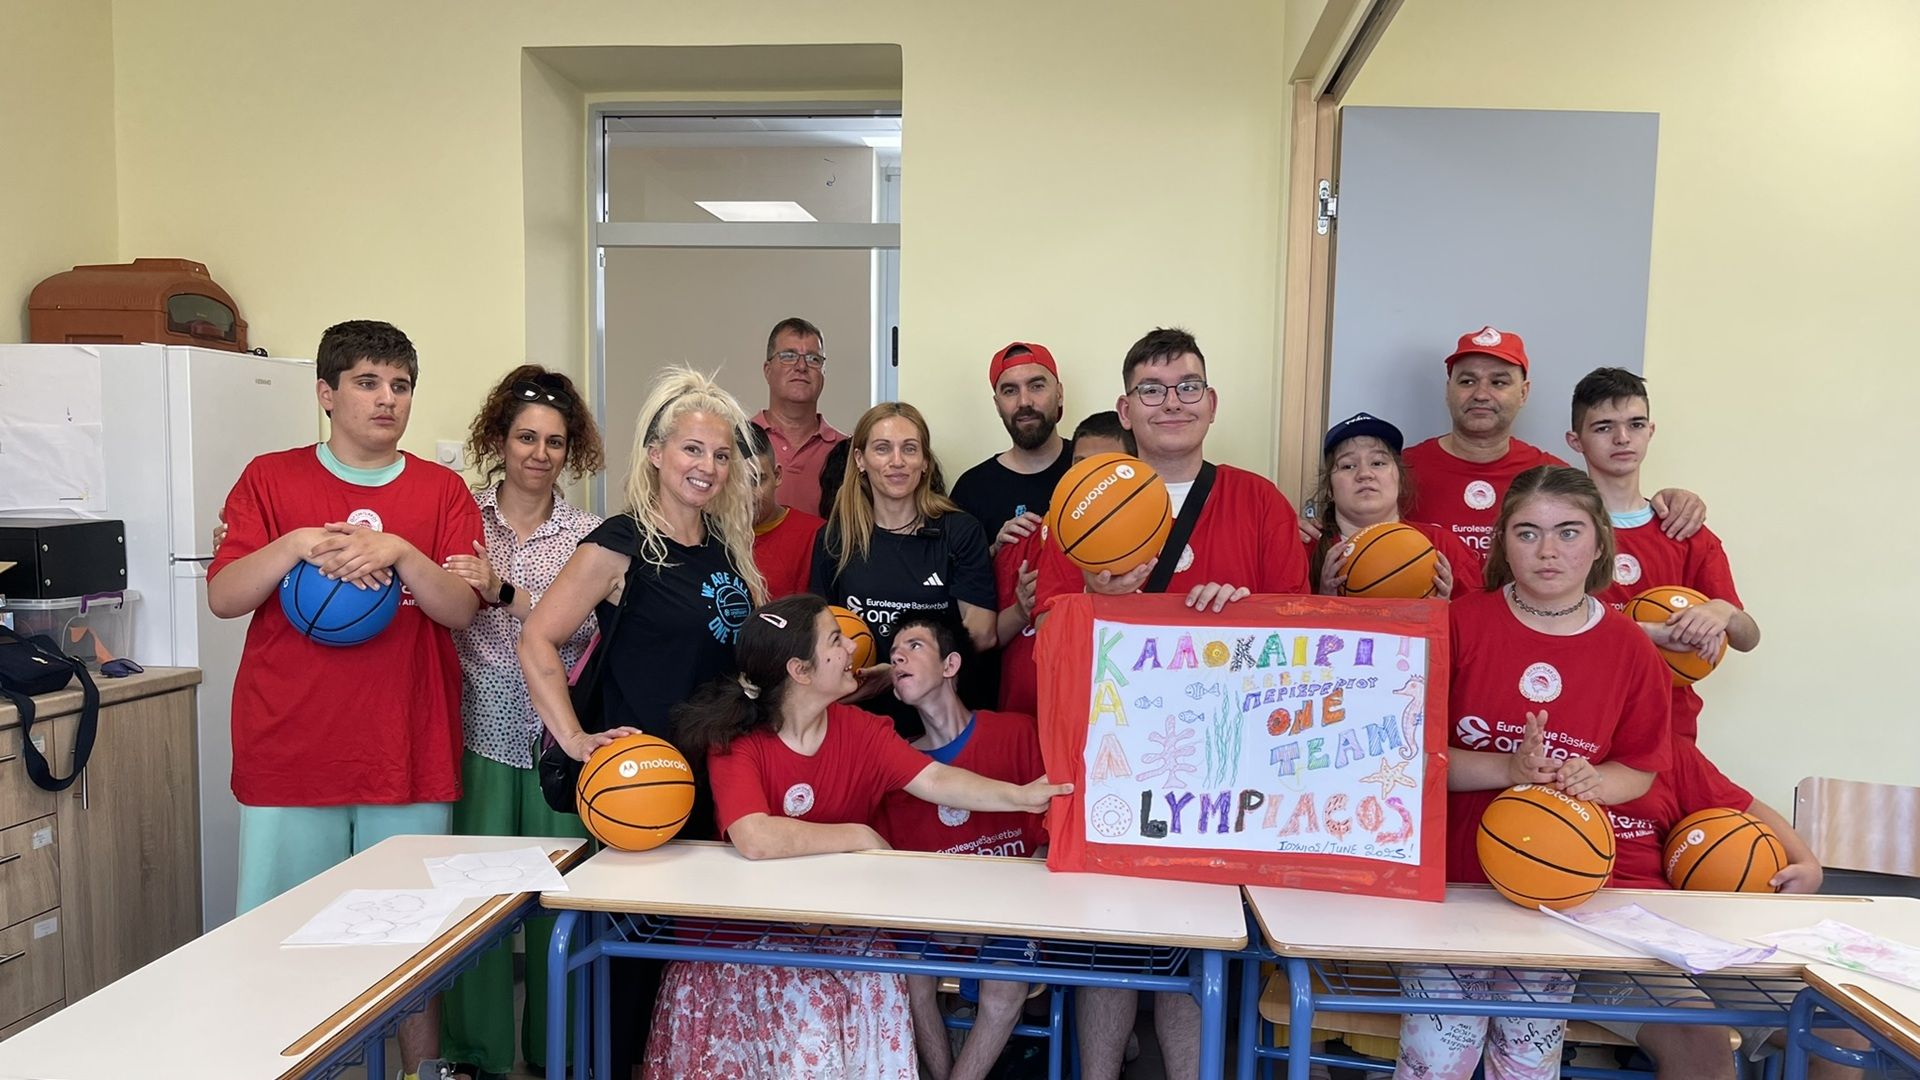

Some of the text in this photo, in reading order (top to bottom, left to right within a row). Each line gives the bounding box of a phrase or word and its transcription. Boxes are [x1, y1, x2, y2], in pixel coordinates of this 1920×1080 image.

[1071, 473, 1118, 520] motorola
[710, 571, 731, 588] ARE
[866, 598, 949, 612] Euroleague Basketball
[1266, 687, 1347, 737] ONE
[1269, 714, 1403, 777] TEAM
[640, 758, 687, 772] motorola
[1532, 785, 1590, 822] motorola
